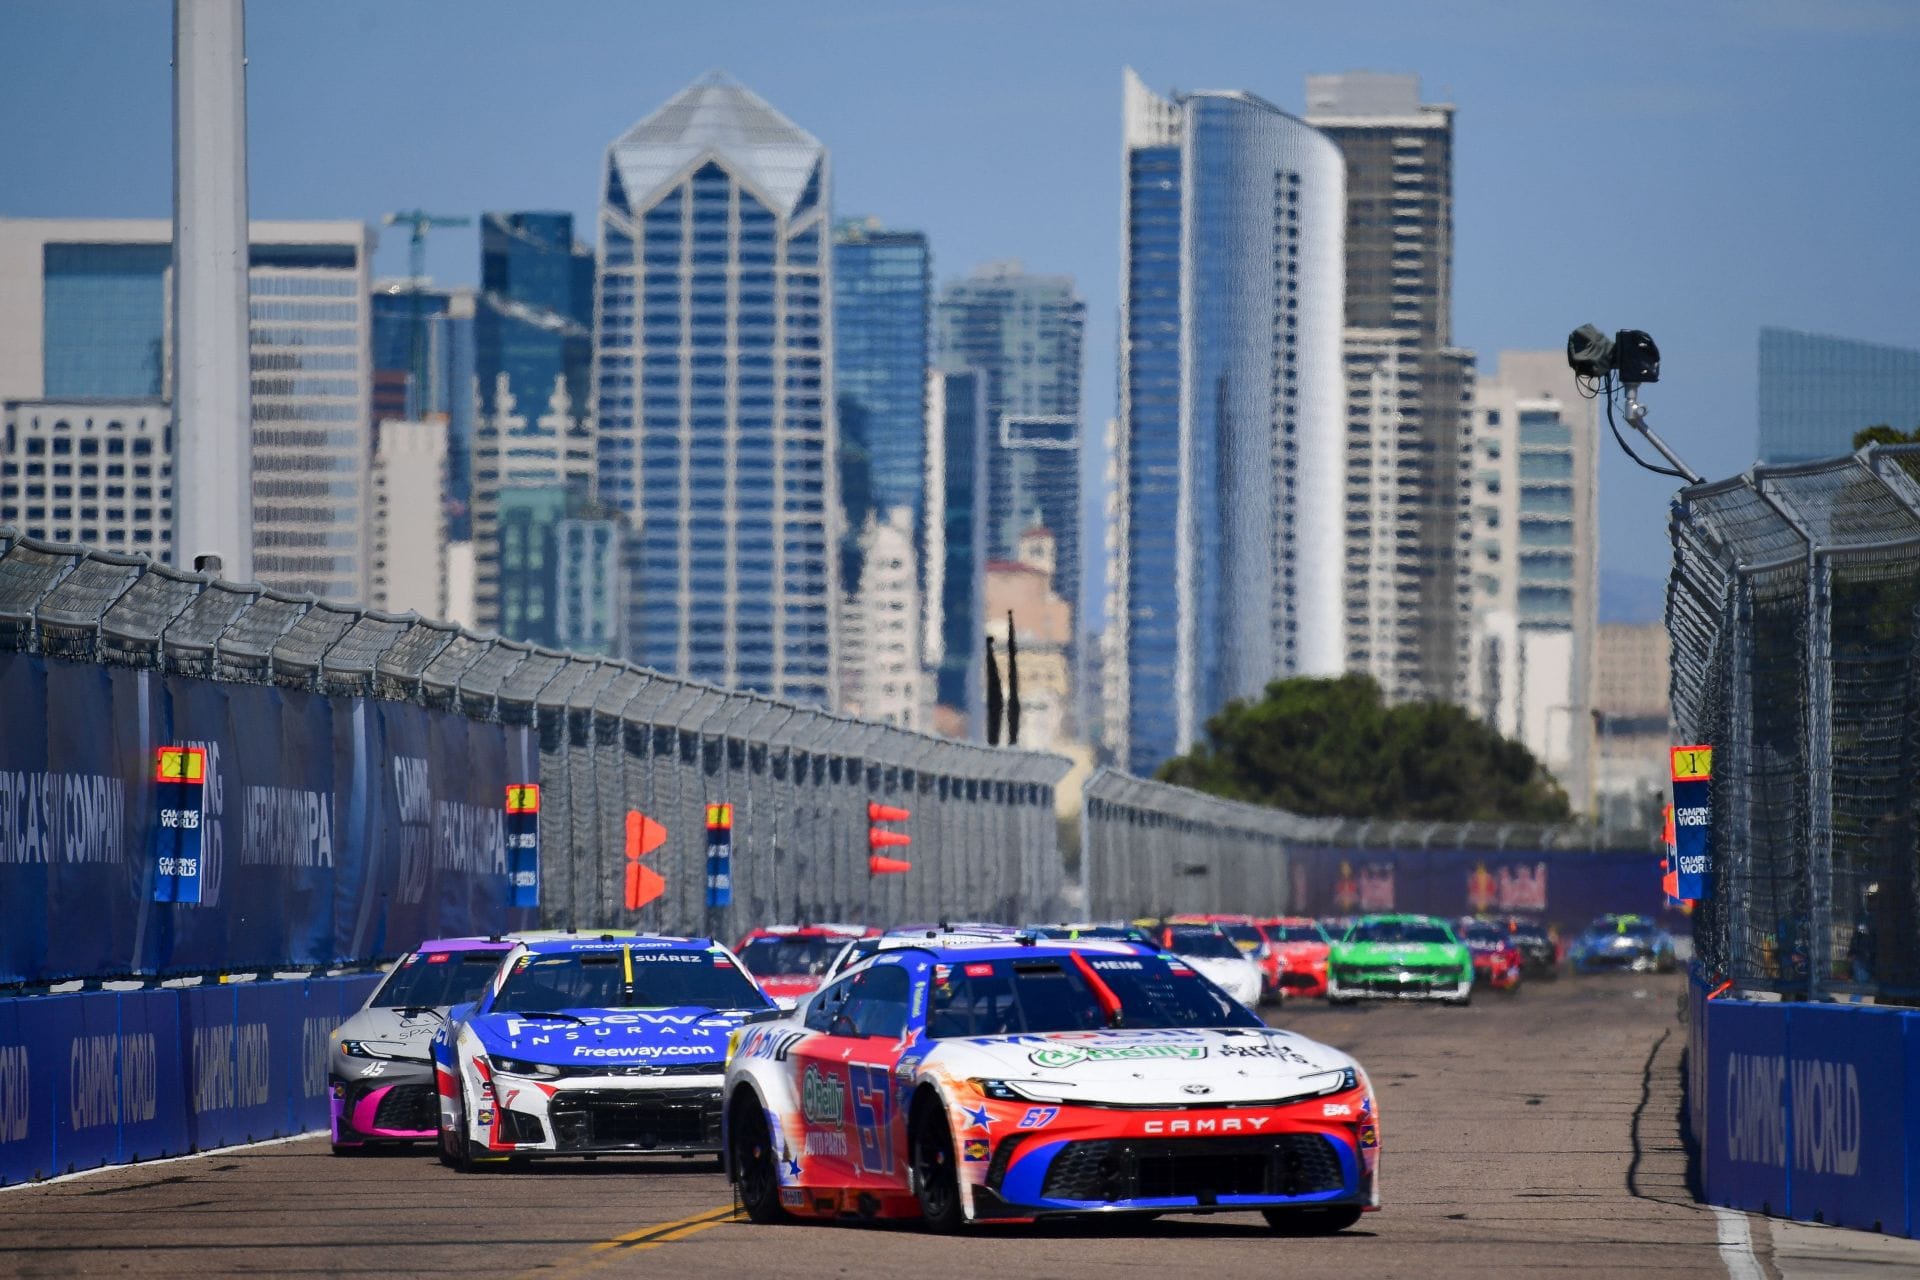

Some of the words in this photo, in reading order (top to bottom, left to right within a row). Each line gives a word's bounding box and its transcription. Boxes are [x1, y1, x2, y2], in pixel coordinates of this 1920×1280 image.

[1689, 753, 1698, 773] 1
[161, 809, 199, 819] CAMPING
[162, 818, 199, 828] WORLD
[159, 857, 196, 867] CAMPING
[159, 866, 196, 876] WORLD
[635, 954, 702, 963] SUÁREZ
[1092, 960, 1143, 970] HEIM
[573, 1045, 715, 1058] Freeway.com
[361, 1062, 387, 1077] 45
[504, 1089, 520, 1110] 7
[848, 1061, 895, 1176] 67
[1017, 1106, 1060, 1129] 67
[1727, 1052, 1785, 1167] CAMPING
[1790, 1058, 1860, 1175] WORLD
[1144, 1117, 1270, 1133] CAMRY
